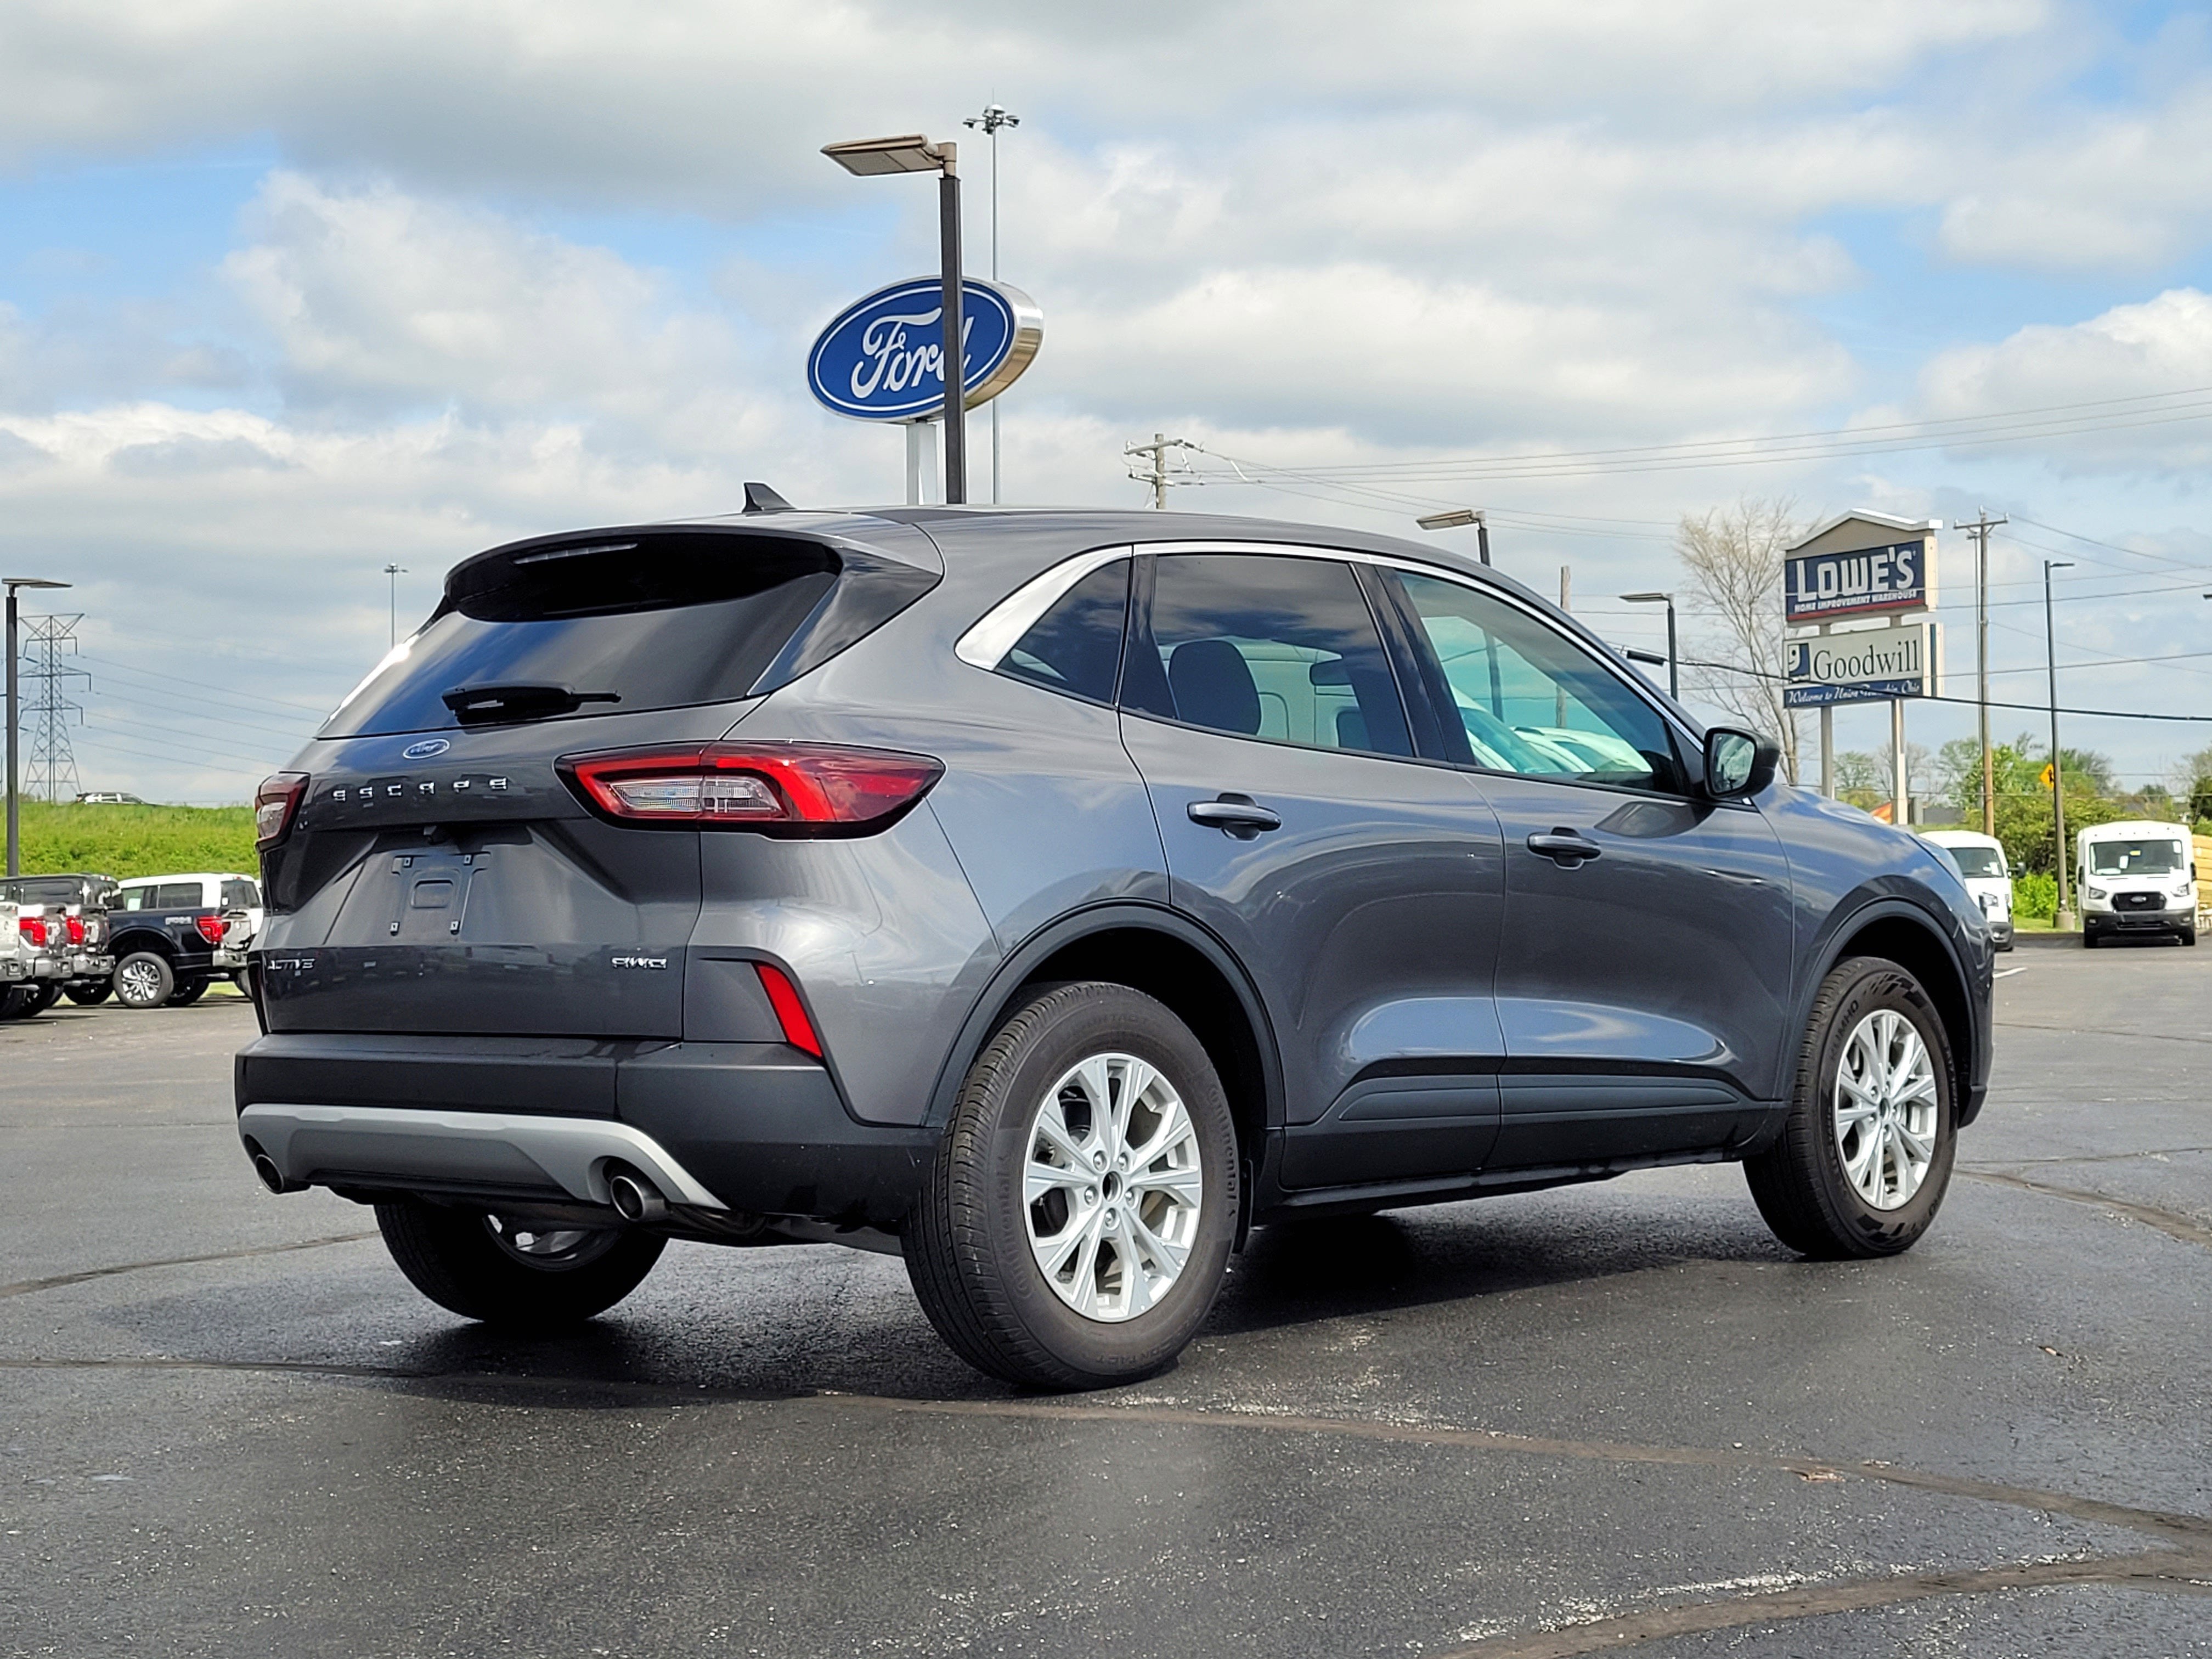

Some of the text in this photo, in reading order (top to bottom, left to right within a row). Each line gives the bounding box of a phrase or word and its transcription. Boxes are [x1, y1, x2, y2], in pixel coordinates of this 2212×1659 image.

[1796, 547, 1915, 602] LOWE'S
[1795, 589, 1917, 613] HOME IMPROVEMENT WAREHOUSE
[1814, 639, 1918, 680] Goodwill
[1788, 690, 1822, 703] Welcome
[1824, 691, 1833, 701] to
[332, 777, 507, 802] ESCAPE
[612, 957, 667, 968] AWD
